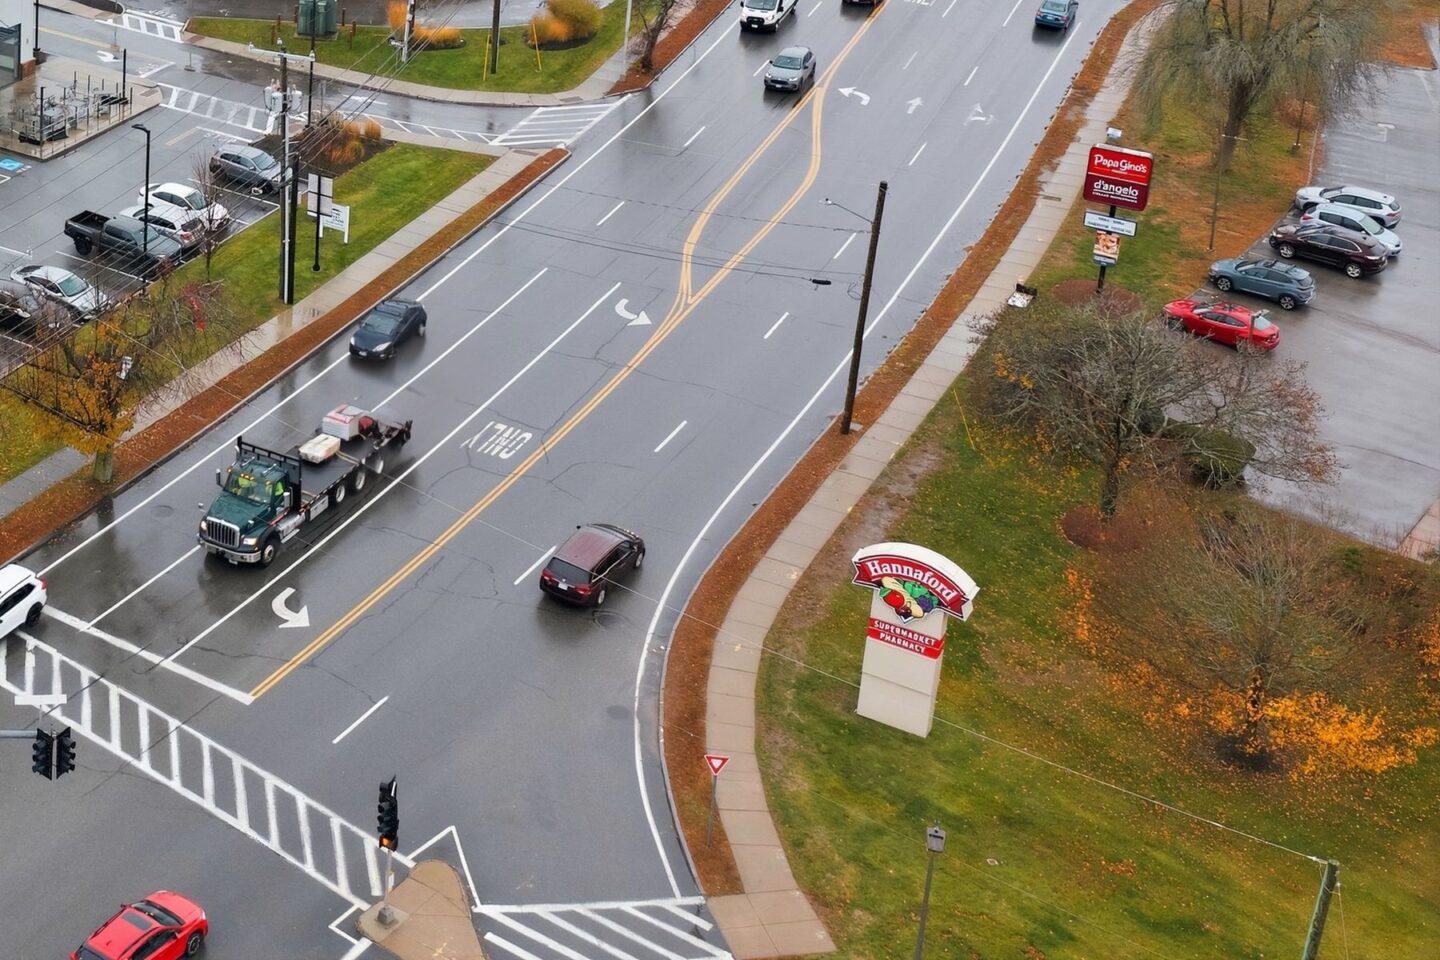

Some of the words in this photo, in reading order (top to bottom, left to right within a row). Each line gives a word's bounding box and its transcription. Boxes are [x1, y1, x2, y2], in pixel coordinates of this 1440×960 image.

[1093, 154, 1119, 168] Papa
[1119, 159, 1148, 174] Gino's
[1093, 180, 1139, 197] d'angelo
[459, 420, 533, 460] ONLY
[865, 559, 959, 600] Hannaford
[873, 620, 936, 646] SUPERMARKET
[880, 632, 926, 654] PHARMACY
